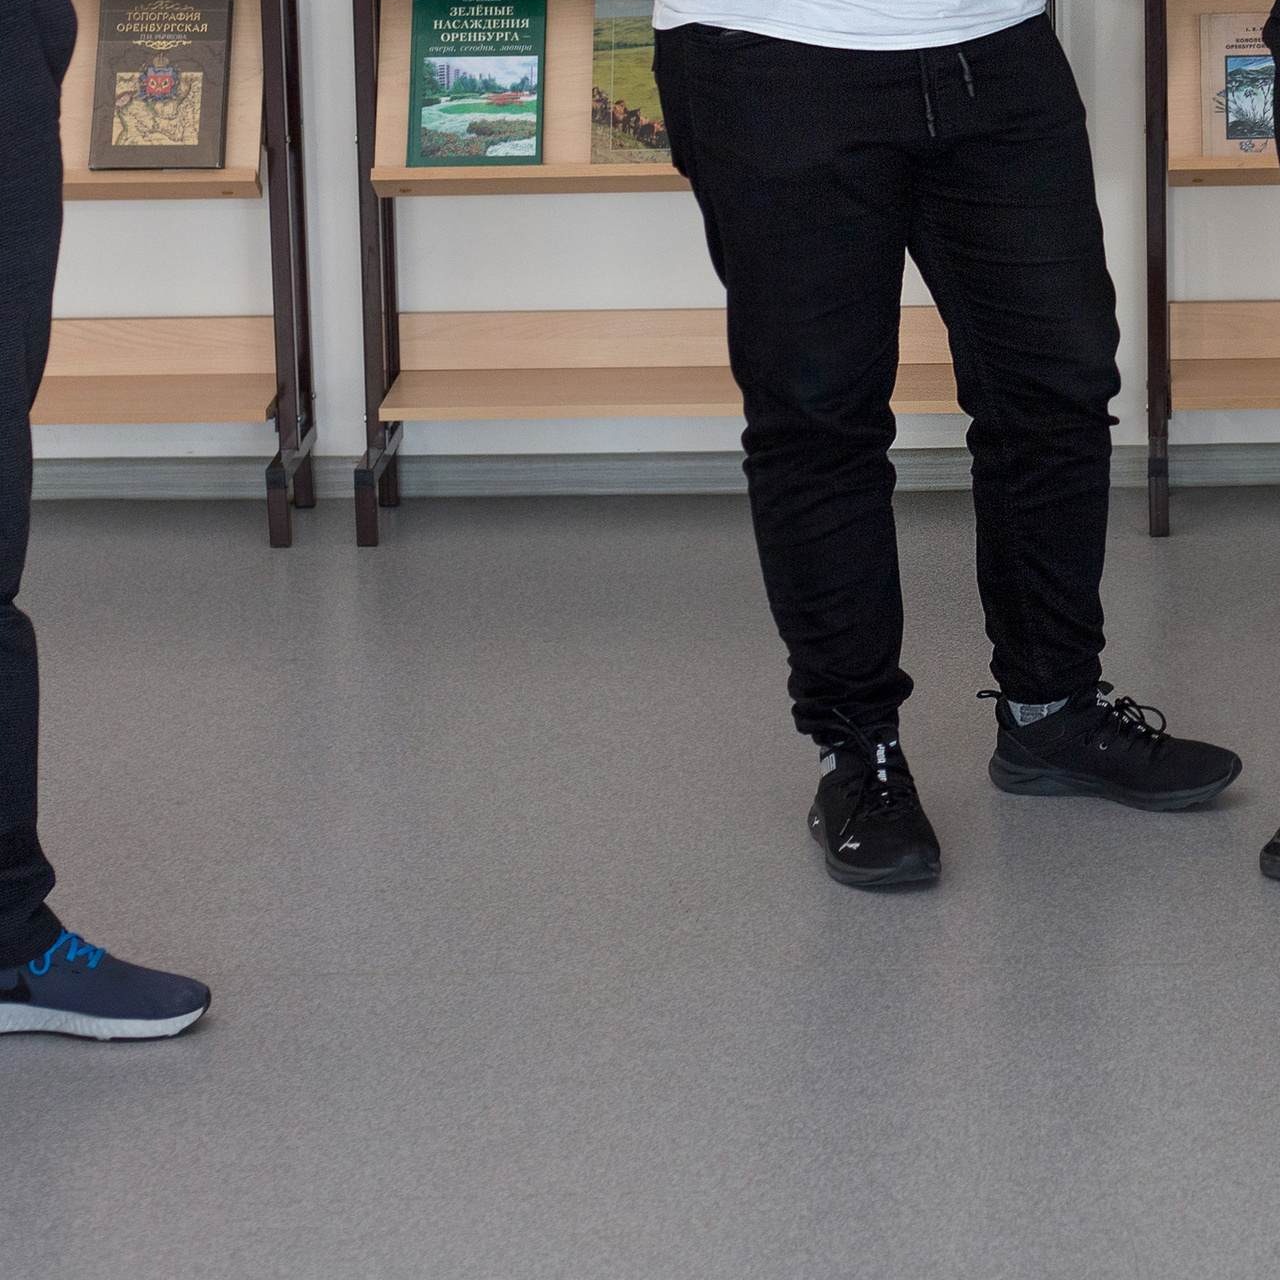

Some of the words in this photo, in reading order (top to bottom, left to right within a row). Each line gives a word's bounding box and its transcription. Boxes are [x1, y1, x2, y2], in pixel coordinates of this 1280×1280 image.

[449, 4, 514, 17] ЗЕЛЁНЫЕ
[126, 12, 201, 22] ТОПОГРАФИЯ
[116, 23, 208, 33] ОРЕНБУРГСКАЯ
[433, 19, 530, 30] НАСАЖДЕНИЯ
[440, 32, 519, 43] ОРЕНБУРГА
[429, 45, 456, 53] вчера,
[460, 44, 496, 53] сегодня,
[499, 44, 533, 53] завтра
